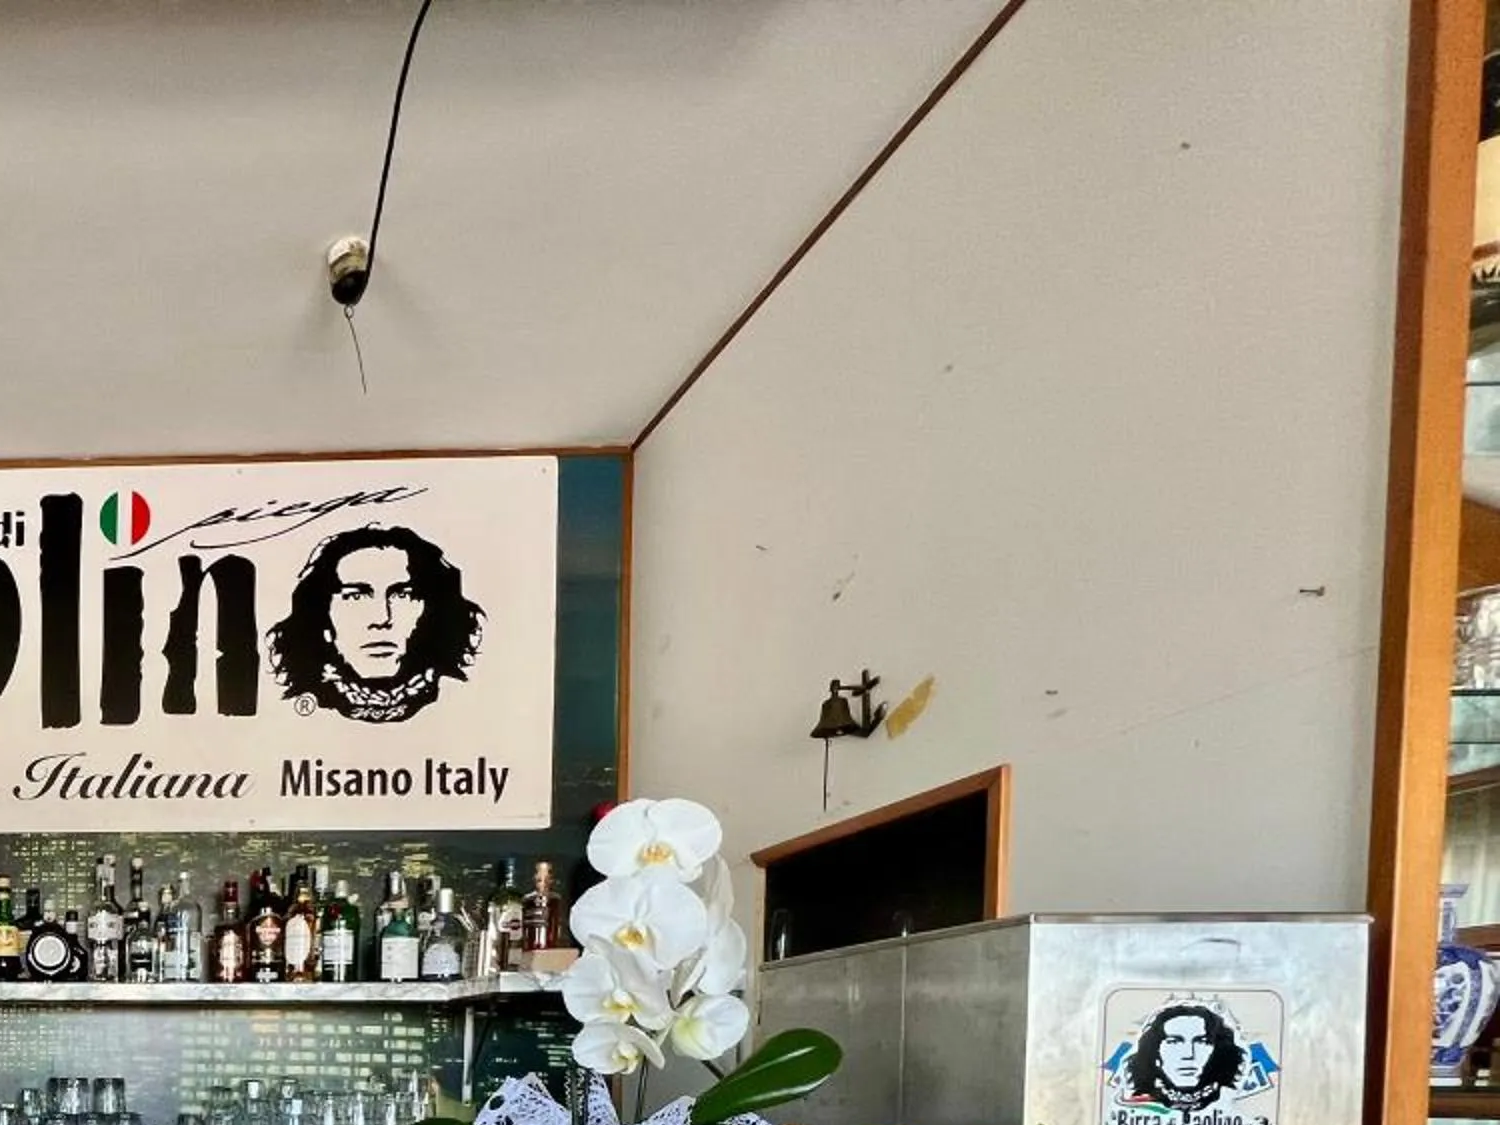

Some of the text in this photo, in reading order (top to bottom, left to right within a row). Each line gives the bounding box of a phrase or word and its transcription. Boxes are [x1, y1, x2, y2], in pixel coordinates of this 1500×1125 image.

[12, 752, 252, 800] Italiana
[279, 758, 413, 798] Misano
[424, 756, 510, 804] Italy
